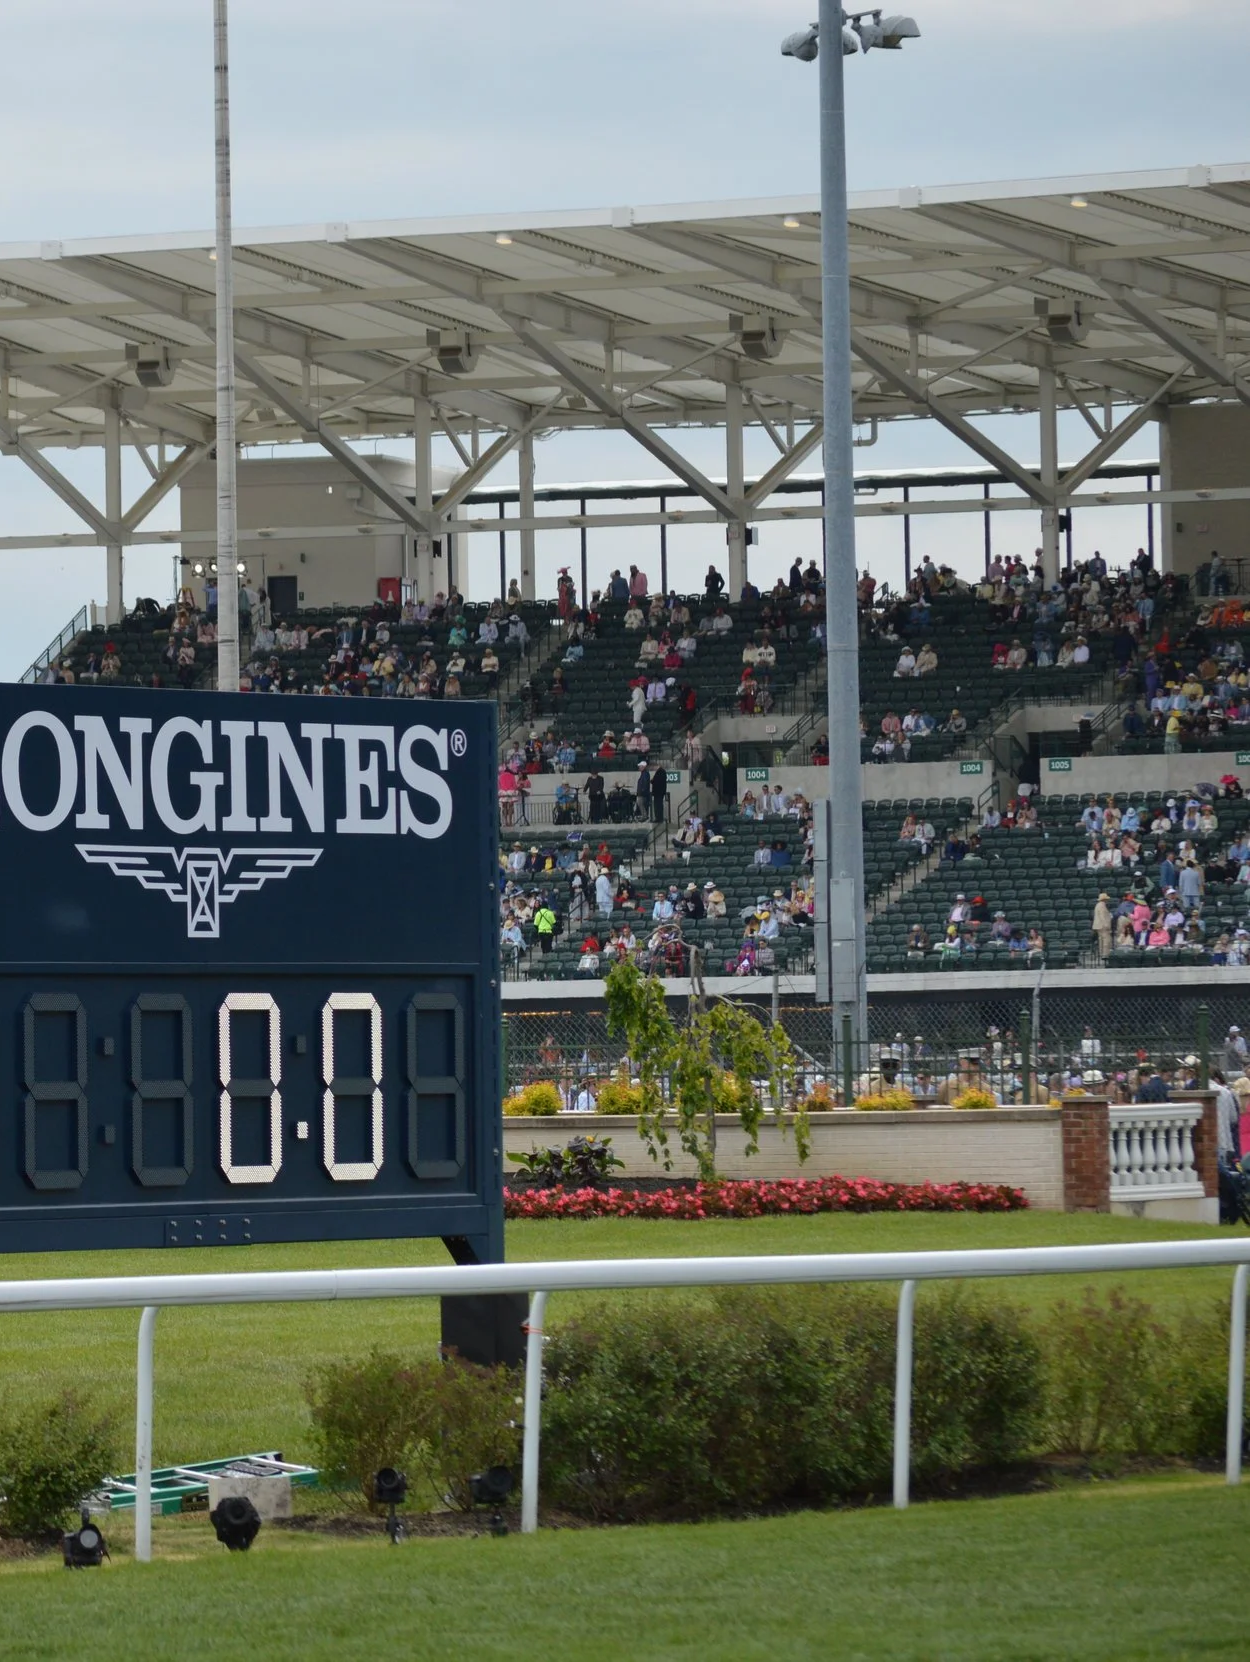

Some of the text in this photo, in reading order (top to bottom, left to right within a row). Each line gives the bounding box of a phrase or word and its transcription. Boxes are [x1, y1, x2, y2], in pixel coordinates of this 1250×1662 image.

[962, 763, 981, 772] 1004
[1050, 759, 1070, 769] 1005
[747, 770, 766, 779] 1004
